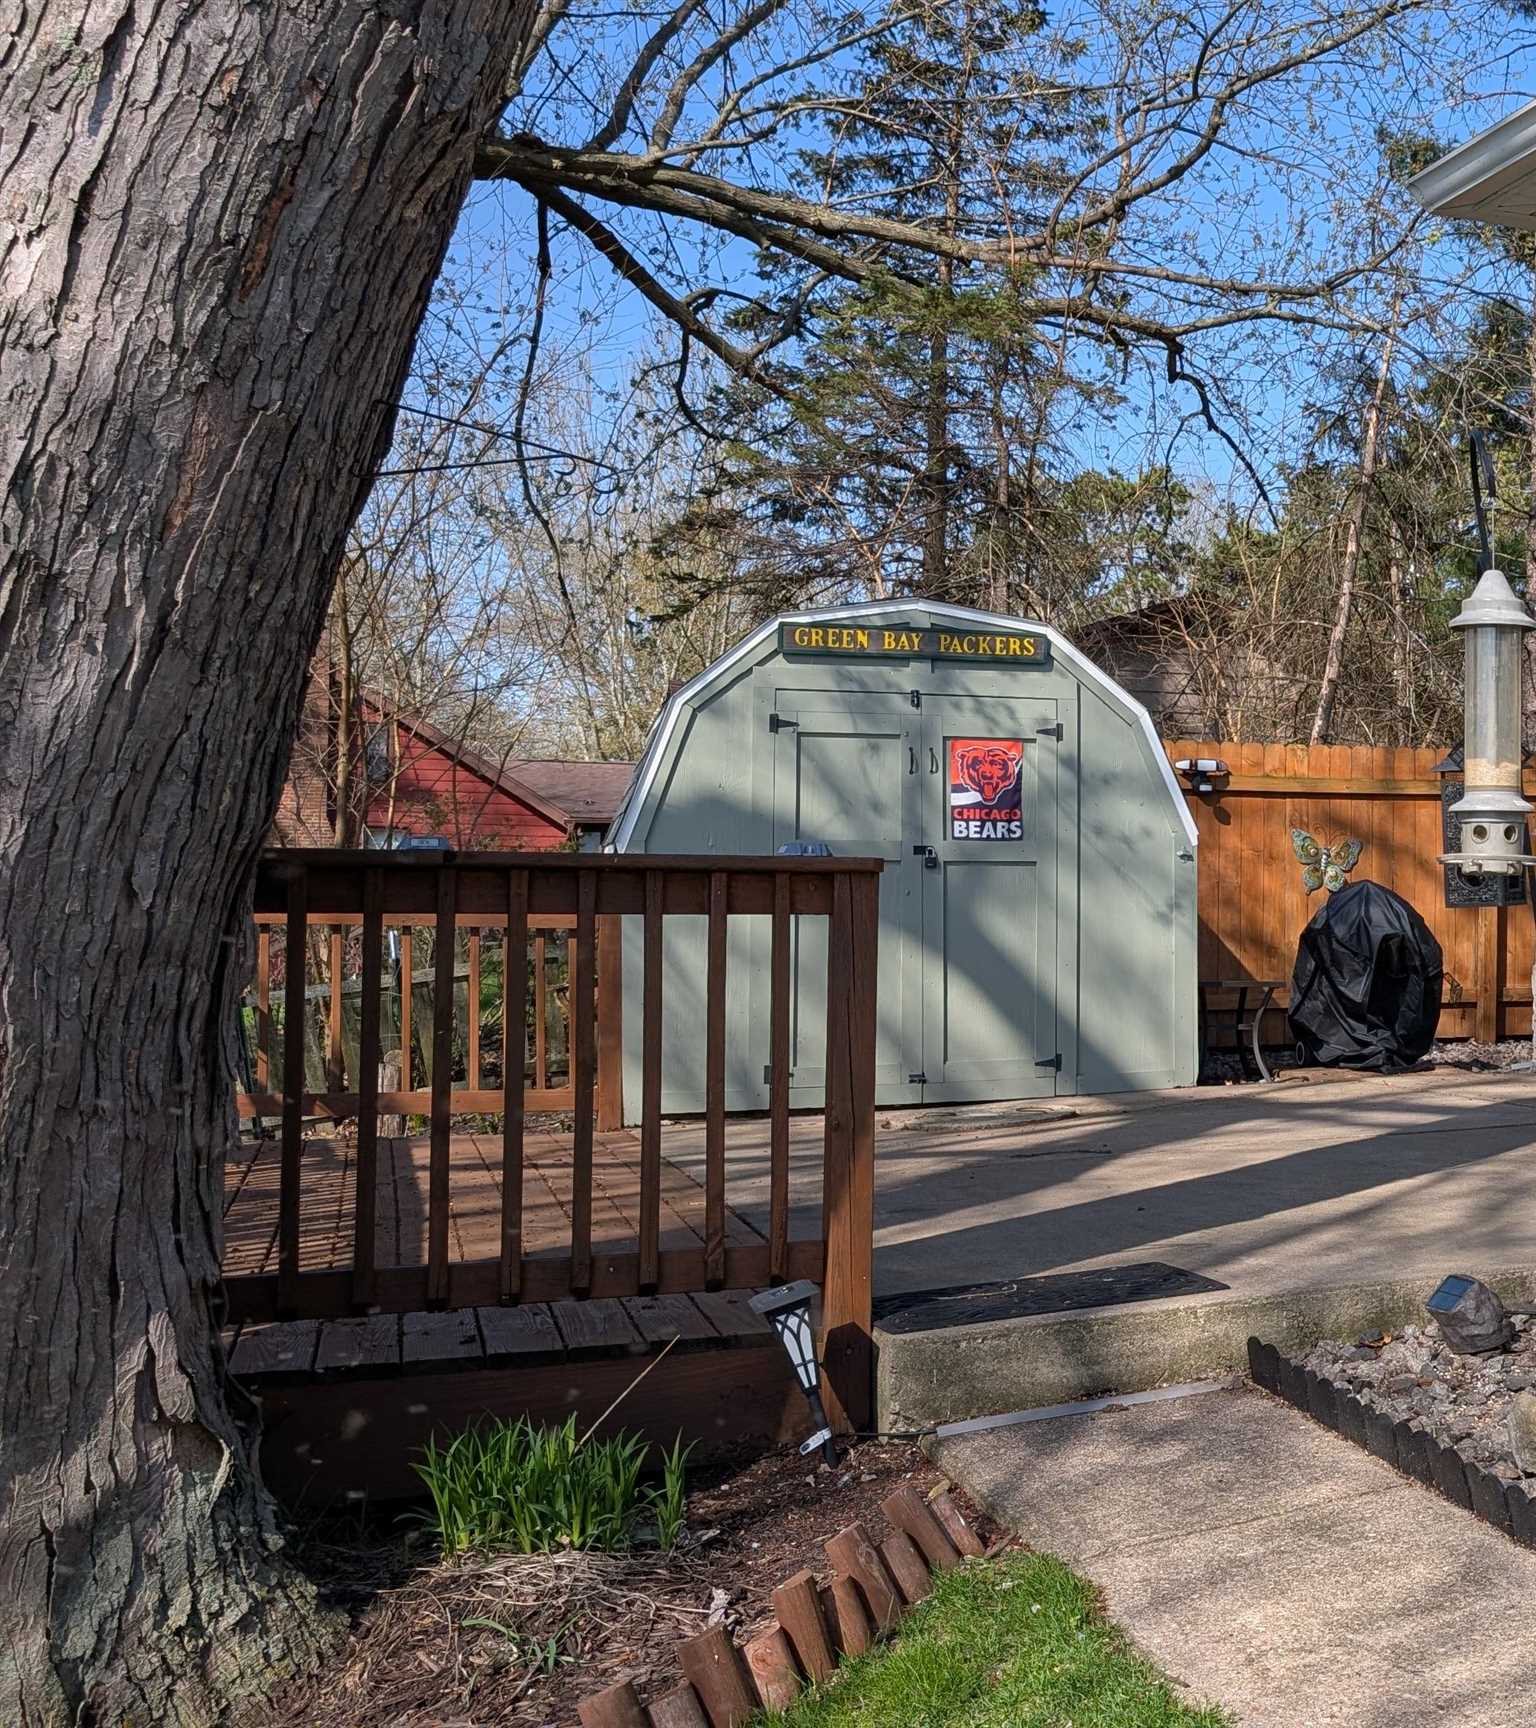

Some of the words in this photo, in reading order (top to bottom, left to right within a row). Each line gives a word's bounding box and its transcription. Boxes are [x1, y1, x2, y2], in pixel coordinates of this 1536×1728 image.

[794, 627, 869, 649] GREEN
[883, 631, 922, 650] BAY
[939, 634, 1035, 656] PACKERS
[953, 808, 1021, 820] CHICAGO
[953, 820, 1022, 838] BEARS
